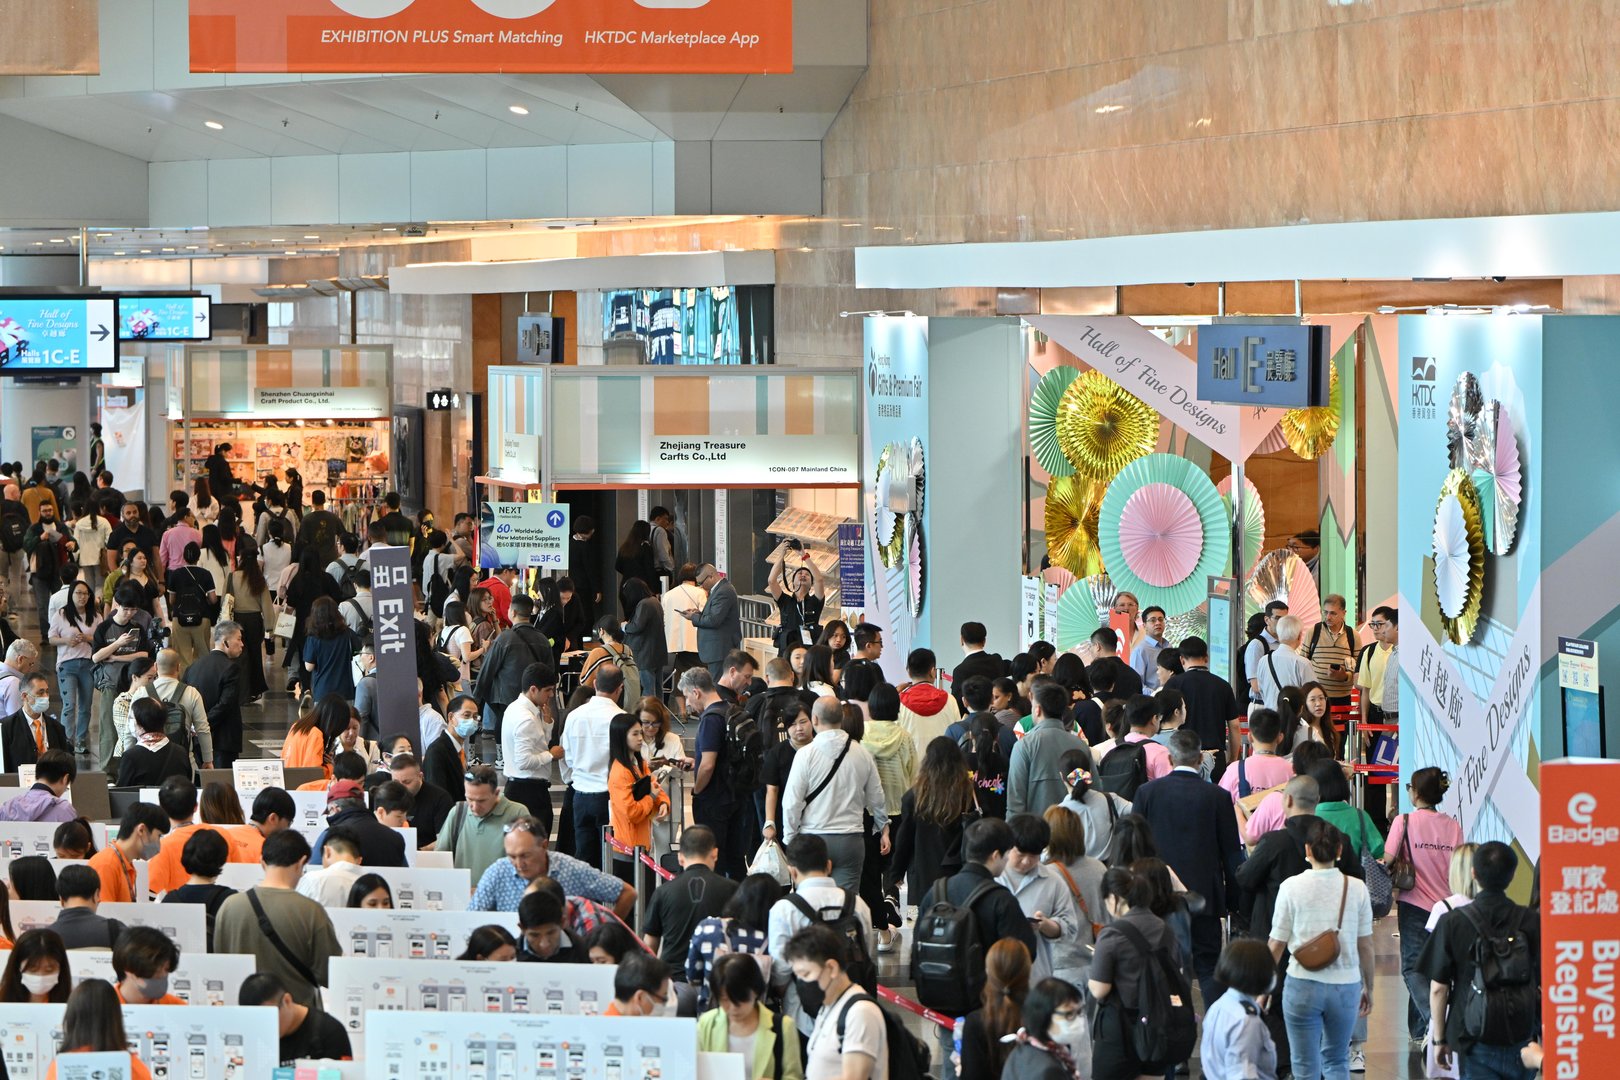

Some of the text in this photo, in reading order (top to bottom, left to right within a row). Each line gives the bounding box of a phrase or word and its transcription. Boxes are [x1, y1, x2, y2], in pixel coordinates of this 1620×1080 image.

[321, 29, 562, 46] EXHIBITION PLUS Smart Matching
[584, 30, 760, 48] HKTDC Marketplace App
[40, 309, 72, 320] Hall of
[46, 319, 79, 330] Designs
[168, 326, 189, 336] 1C-E
[21, 349, 80, 364] Halls 1C-E
[1213, 335, 1264, 393] Hall E
[1080, 324, 1120, 359] Hall
[1115, 356, 1141, 374] of
[1138, 364, 1168, 396] Fine
[1169, 385, 1228, 436] Designs
[292, 391, 335, 399] Chuangxinhai
[660, 441, 746, 451] Zhejiang Treasure
[660, 452, 727, 462] Carfts Co.,Ltd
[498, 506, 522, 514] NEXT
[534, 535, 560, 543] Suppliers
[541, 554, 561, 562] 3F-G
[373, 565, 408, 589] 出口
[378, 598, 406, 654] Exit
[1418, 644, 1463, 729] 卓越廊
[1464, 744, 1487, 805] Fine
[1485, 644, 1531, 752] Designs
[1547, 823, 1619, 847] Badge
[1561, 865, 1607, 890] 買家
[1549, 889, 1619, 915] 登記處
[1585, 939, 1620, 1039] Buyer
[1549, 939, 1586, 1080] Registra
